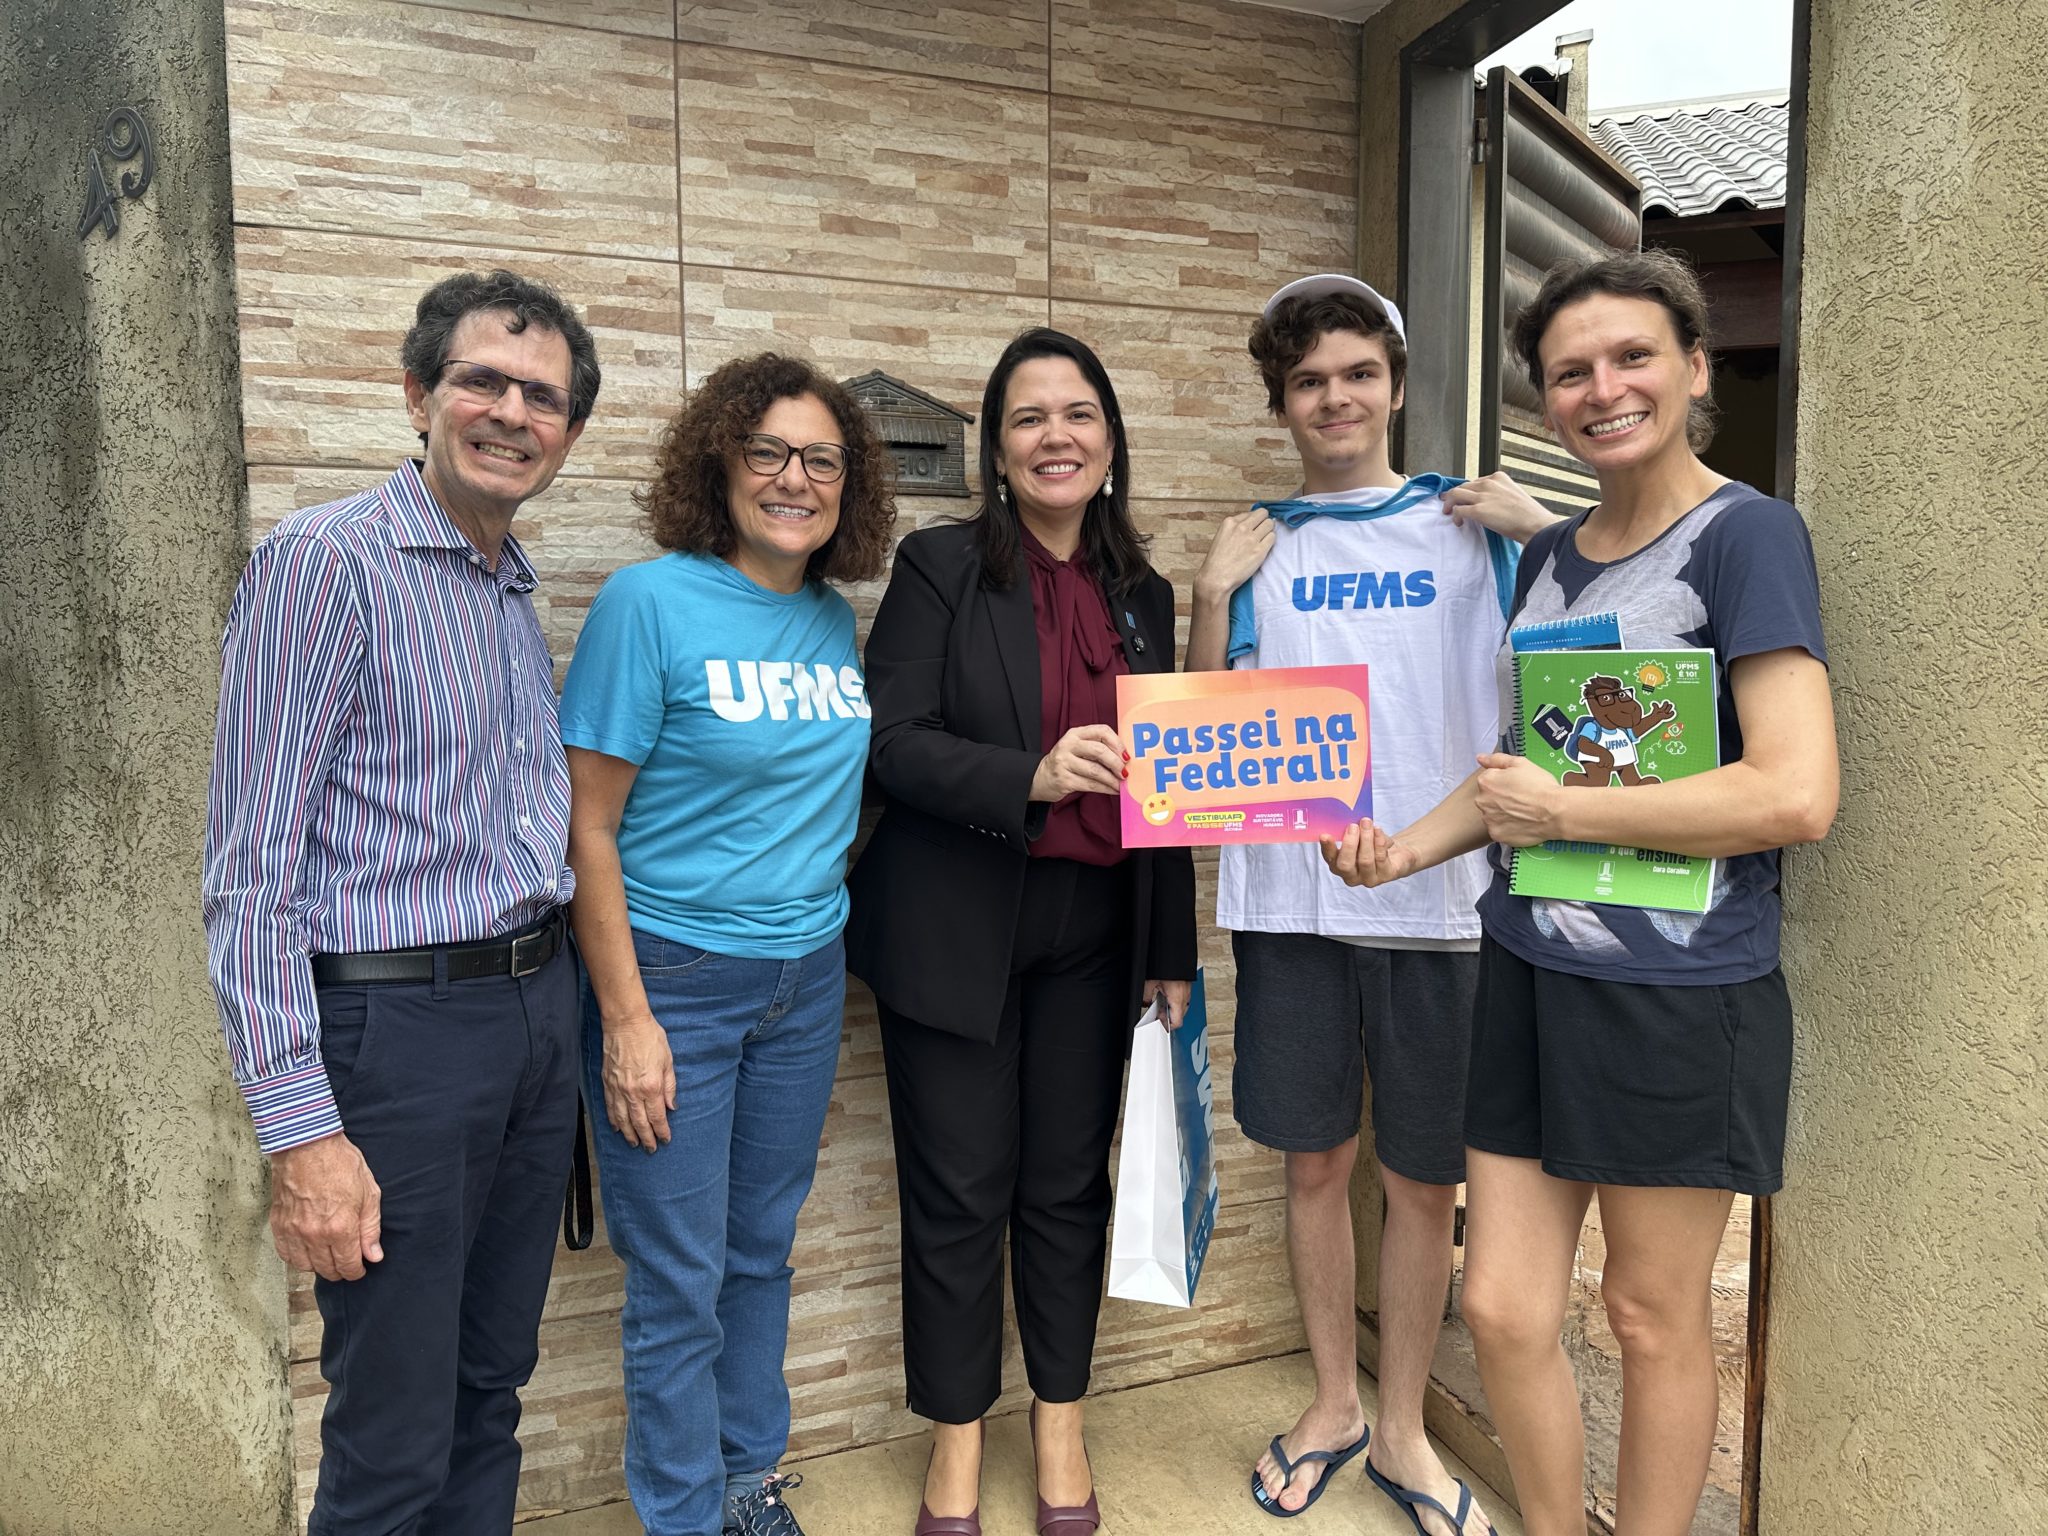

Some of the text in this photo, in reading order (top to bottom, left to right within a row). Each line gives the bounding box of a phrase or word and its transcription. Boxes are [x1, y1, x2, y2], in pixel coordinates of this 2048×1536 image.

[76, 106, 154, 241] 49
[1291, 569, 1437, 612] UFMS
[1675, 663, 1700, 671] UFMS
[1678, 670, 1684, 678] É
[704, 659, 872, 723] UFMS
[1132, 708, 1358, 758] Passei na
[1604, 740, 1629, 751] UFMS
[1153, 743, 1352, 794] Federal!
[1187, 813, 1243, 821] VESTIBULAR
[1609, 846, 1616, 854] o
[1618, 847, 1635, 856] que
